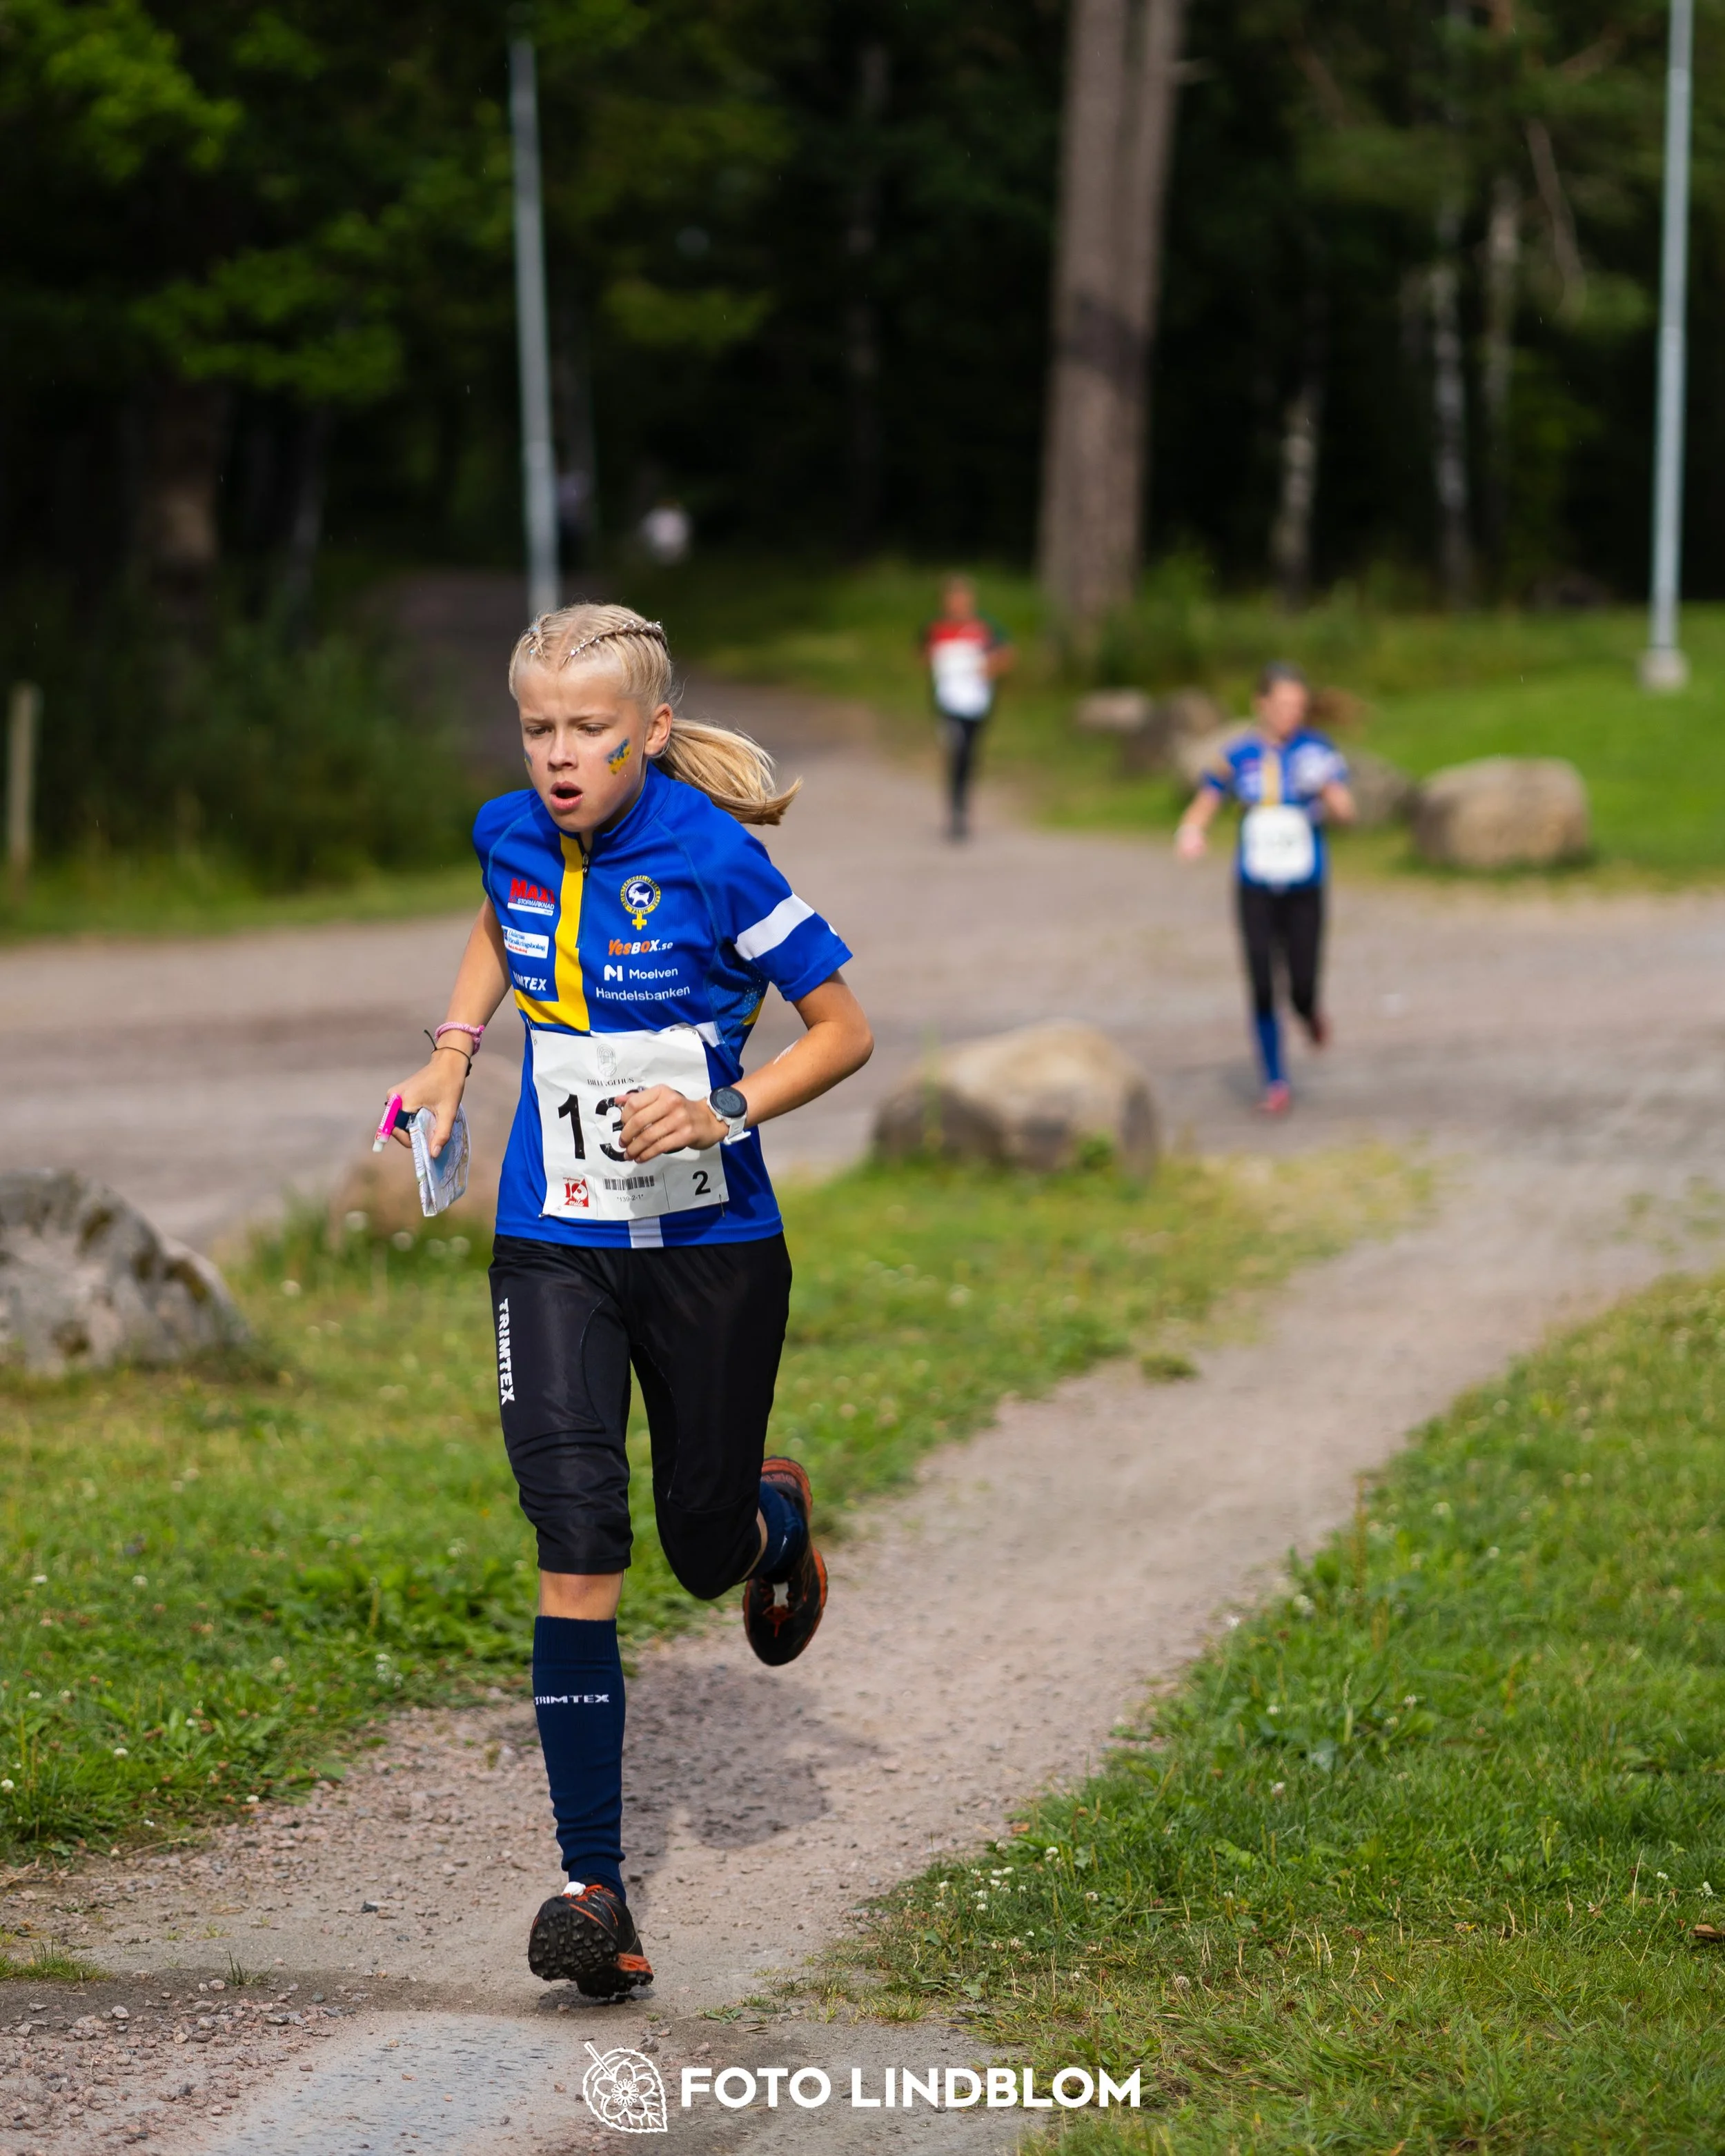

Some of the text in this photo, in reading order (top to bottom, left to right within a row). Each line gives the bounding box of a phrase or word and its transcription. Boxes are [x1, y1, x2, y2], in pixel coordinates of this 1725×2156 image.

[517, 898, 555, 910] STORMARKNAD
[629, 968, 678, 979] Moelven
[596, 986, 690, 1000] Handelsbanken
[692, 1170, 711, 1196] 2
[499, 1298, 515, 1405] TRIMTEX
[535, 1694, 609, 1705] TRIMTEX
